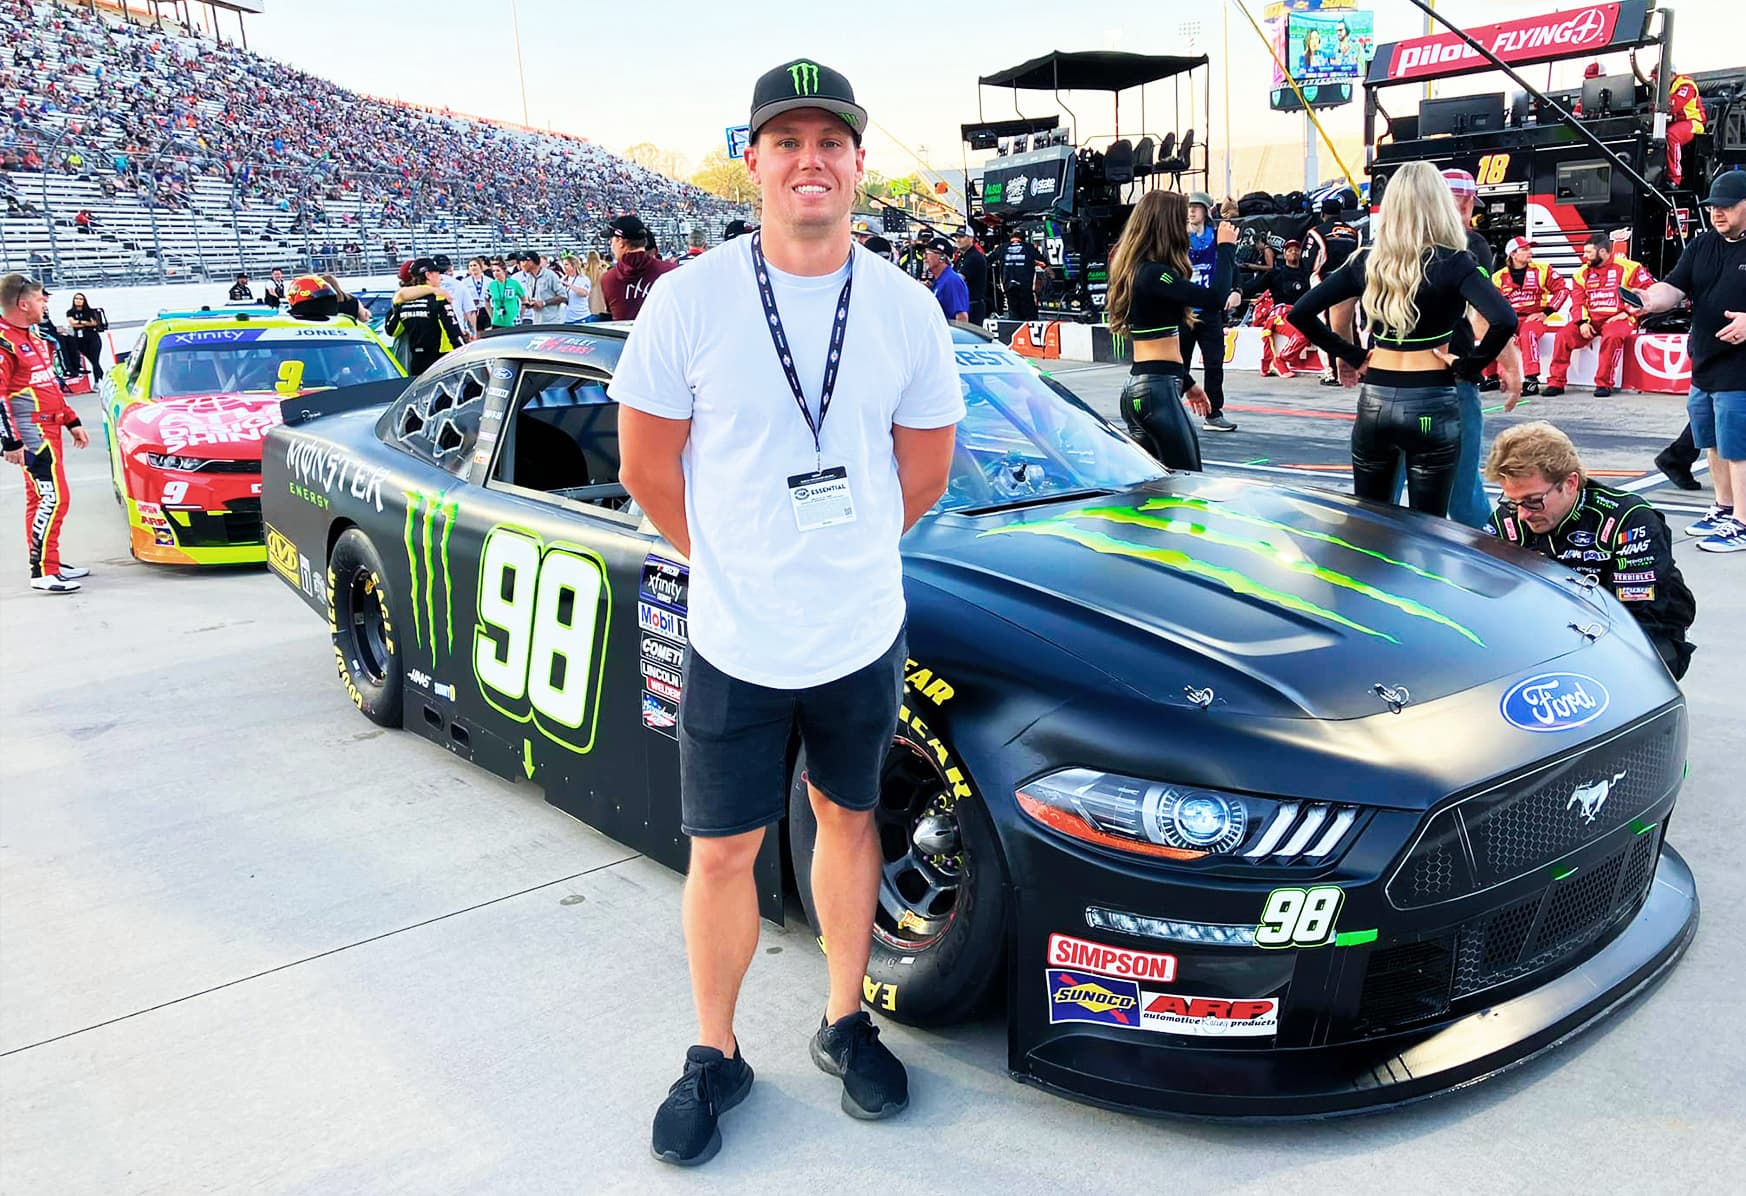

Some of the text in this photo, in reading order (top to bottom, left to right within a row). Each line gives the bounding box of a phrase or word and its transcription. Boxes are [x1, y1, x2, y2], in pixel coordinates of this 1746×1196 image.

[1489, 21, 1573, 52] FLYING
[1476, 153, 1510, 185] 18
[1046, 238, 1064, 265] 27
[175, 330, 244, 344] xfinity
[275, 359, 305, 394] 9
[287, 438, 391, 512] MONSTER
[810, 483, 846, 496] ESSENTIAL
[160, 480, 190, 504] 9
[289, 481, 330, 511] ENERGY
[1631, 526, 1646, 541] 75
[648, 572, 683, 603] xfinity
[641, 604, 674, 634] Mobil
[474, 524, 608, 745] 98
[642, 662, 680, 688] LINCOLN
[1521, 679, 1598, 726] Ford
[1255, 886, 1344, 949] 98
[1055, 939, 1168, 979] SIMPSON
[1055, 987, 1134, 1010] SUNOCO
[1143, 995, 1274, 1021] ARP
[1143, 1012, 1201, 1026] automotive
[1230, 1018, 1276, 1029] products
